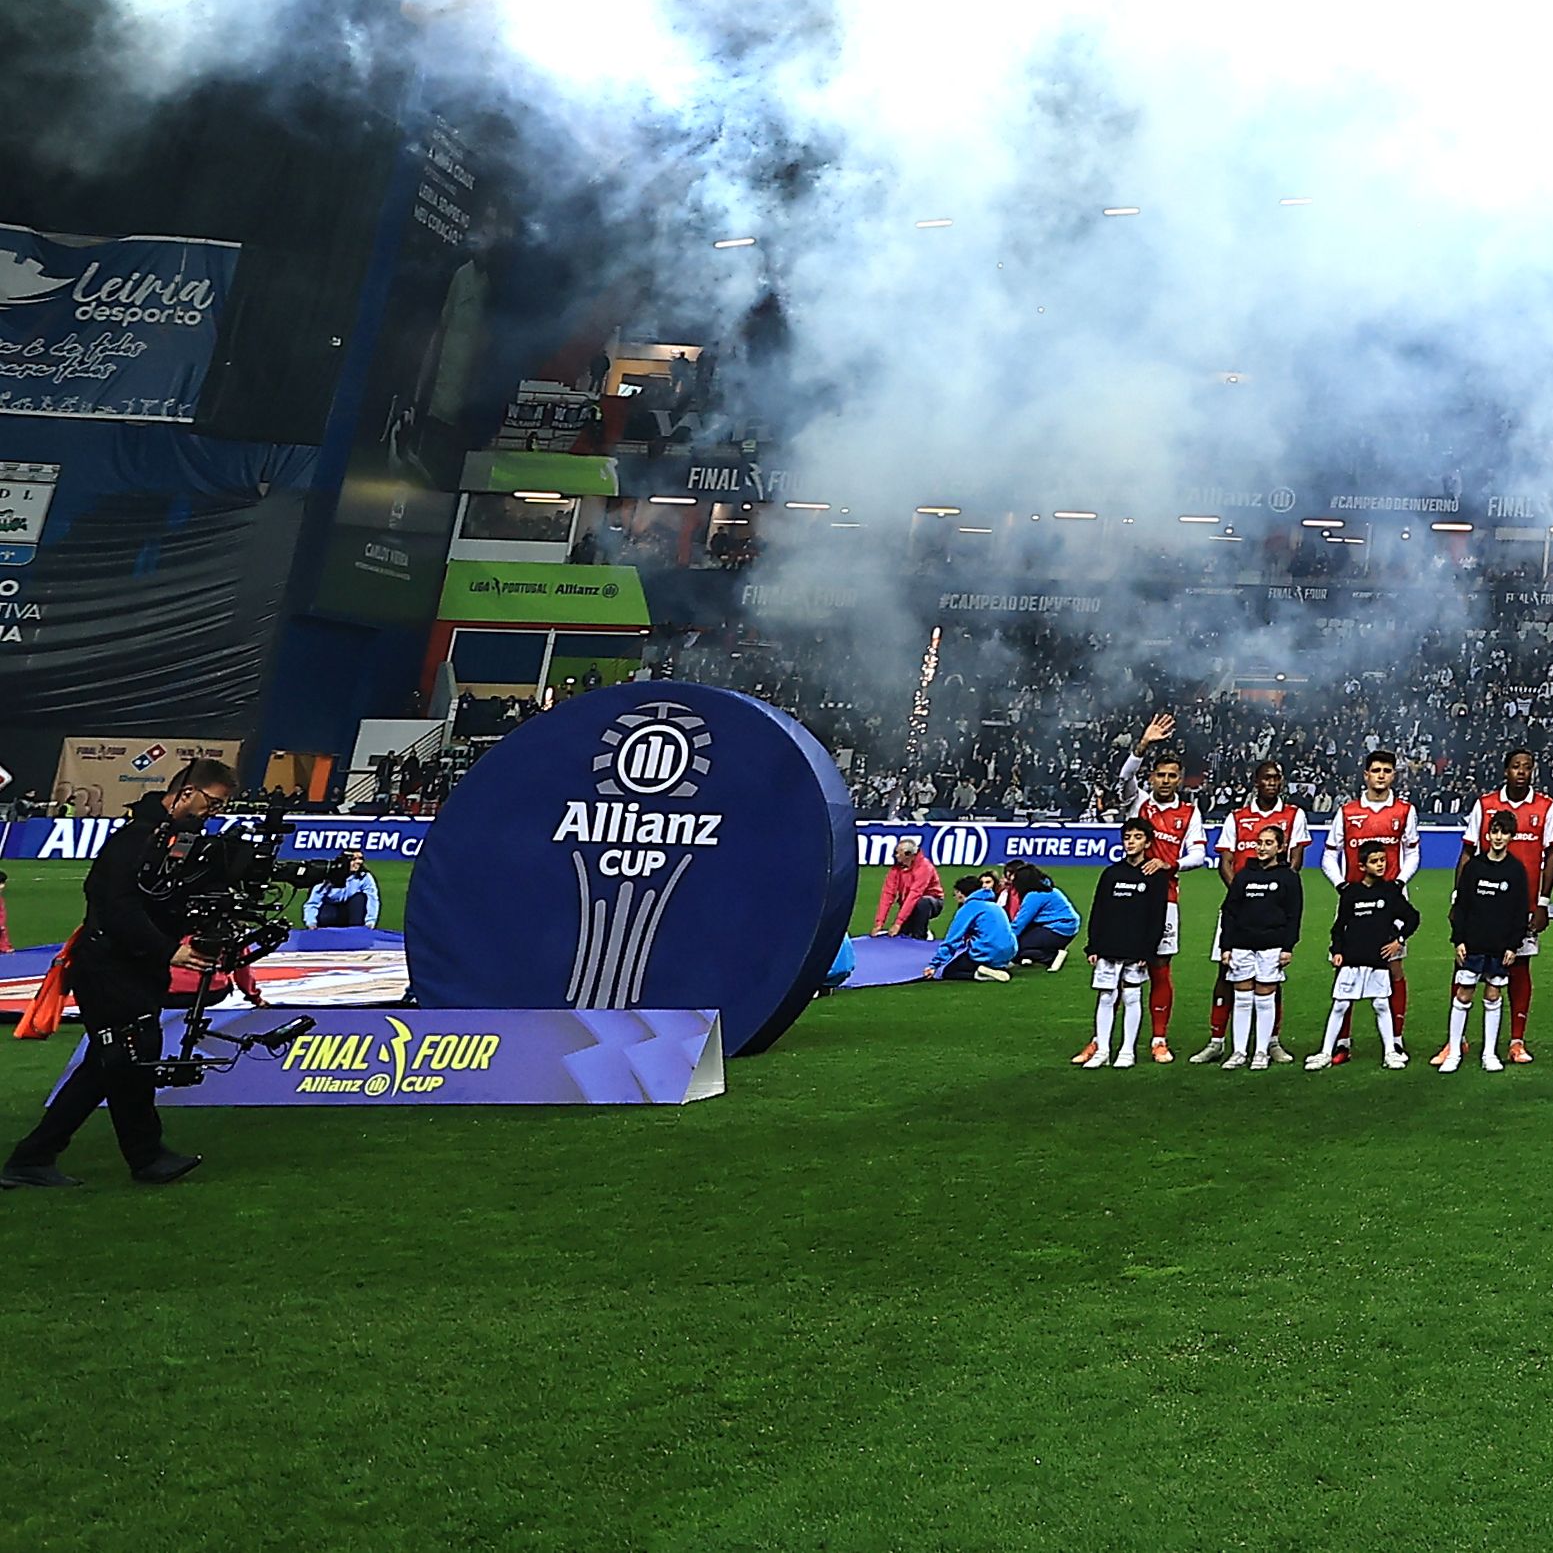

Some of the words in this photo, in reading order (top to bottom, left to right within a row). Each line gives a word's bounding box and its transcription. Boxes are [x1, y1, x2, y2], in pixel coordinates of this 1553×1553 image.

[72, 262, 215, 310] Leiria
[75, 303, 201, 327] desporto
[687, 466, 740, 492] FINAL
[470, 582, 490, 592] LIGA
[502, 583, 547, 594] PORTUGAL
[555, 584, 600, 595] Allianz
[552, 801, 723, 846] Allianz
[293, 830, 363, 851] ENTRE
[364, 831, 400, 851] EM
[1006, 837, 1072, 857] ENTRE
[1074, 838, 1107, 857] EM
[598, 849, 667, 877] CUP
[282, 1034, 374, 1071] FINAL
[410, 1034, 501, 1070] FOUR
[295, 1075, 364, 1094] Allianz
[400, 1075, 444, 1094] CUP
